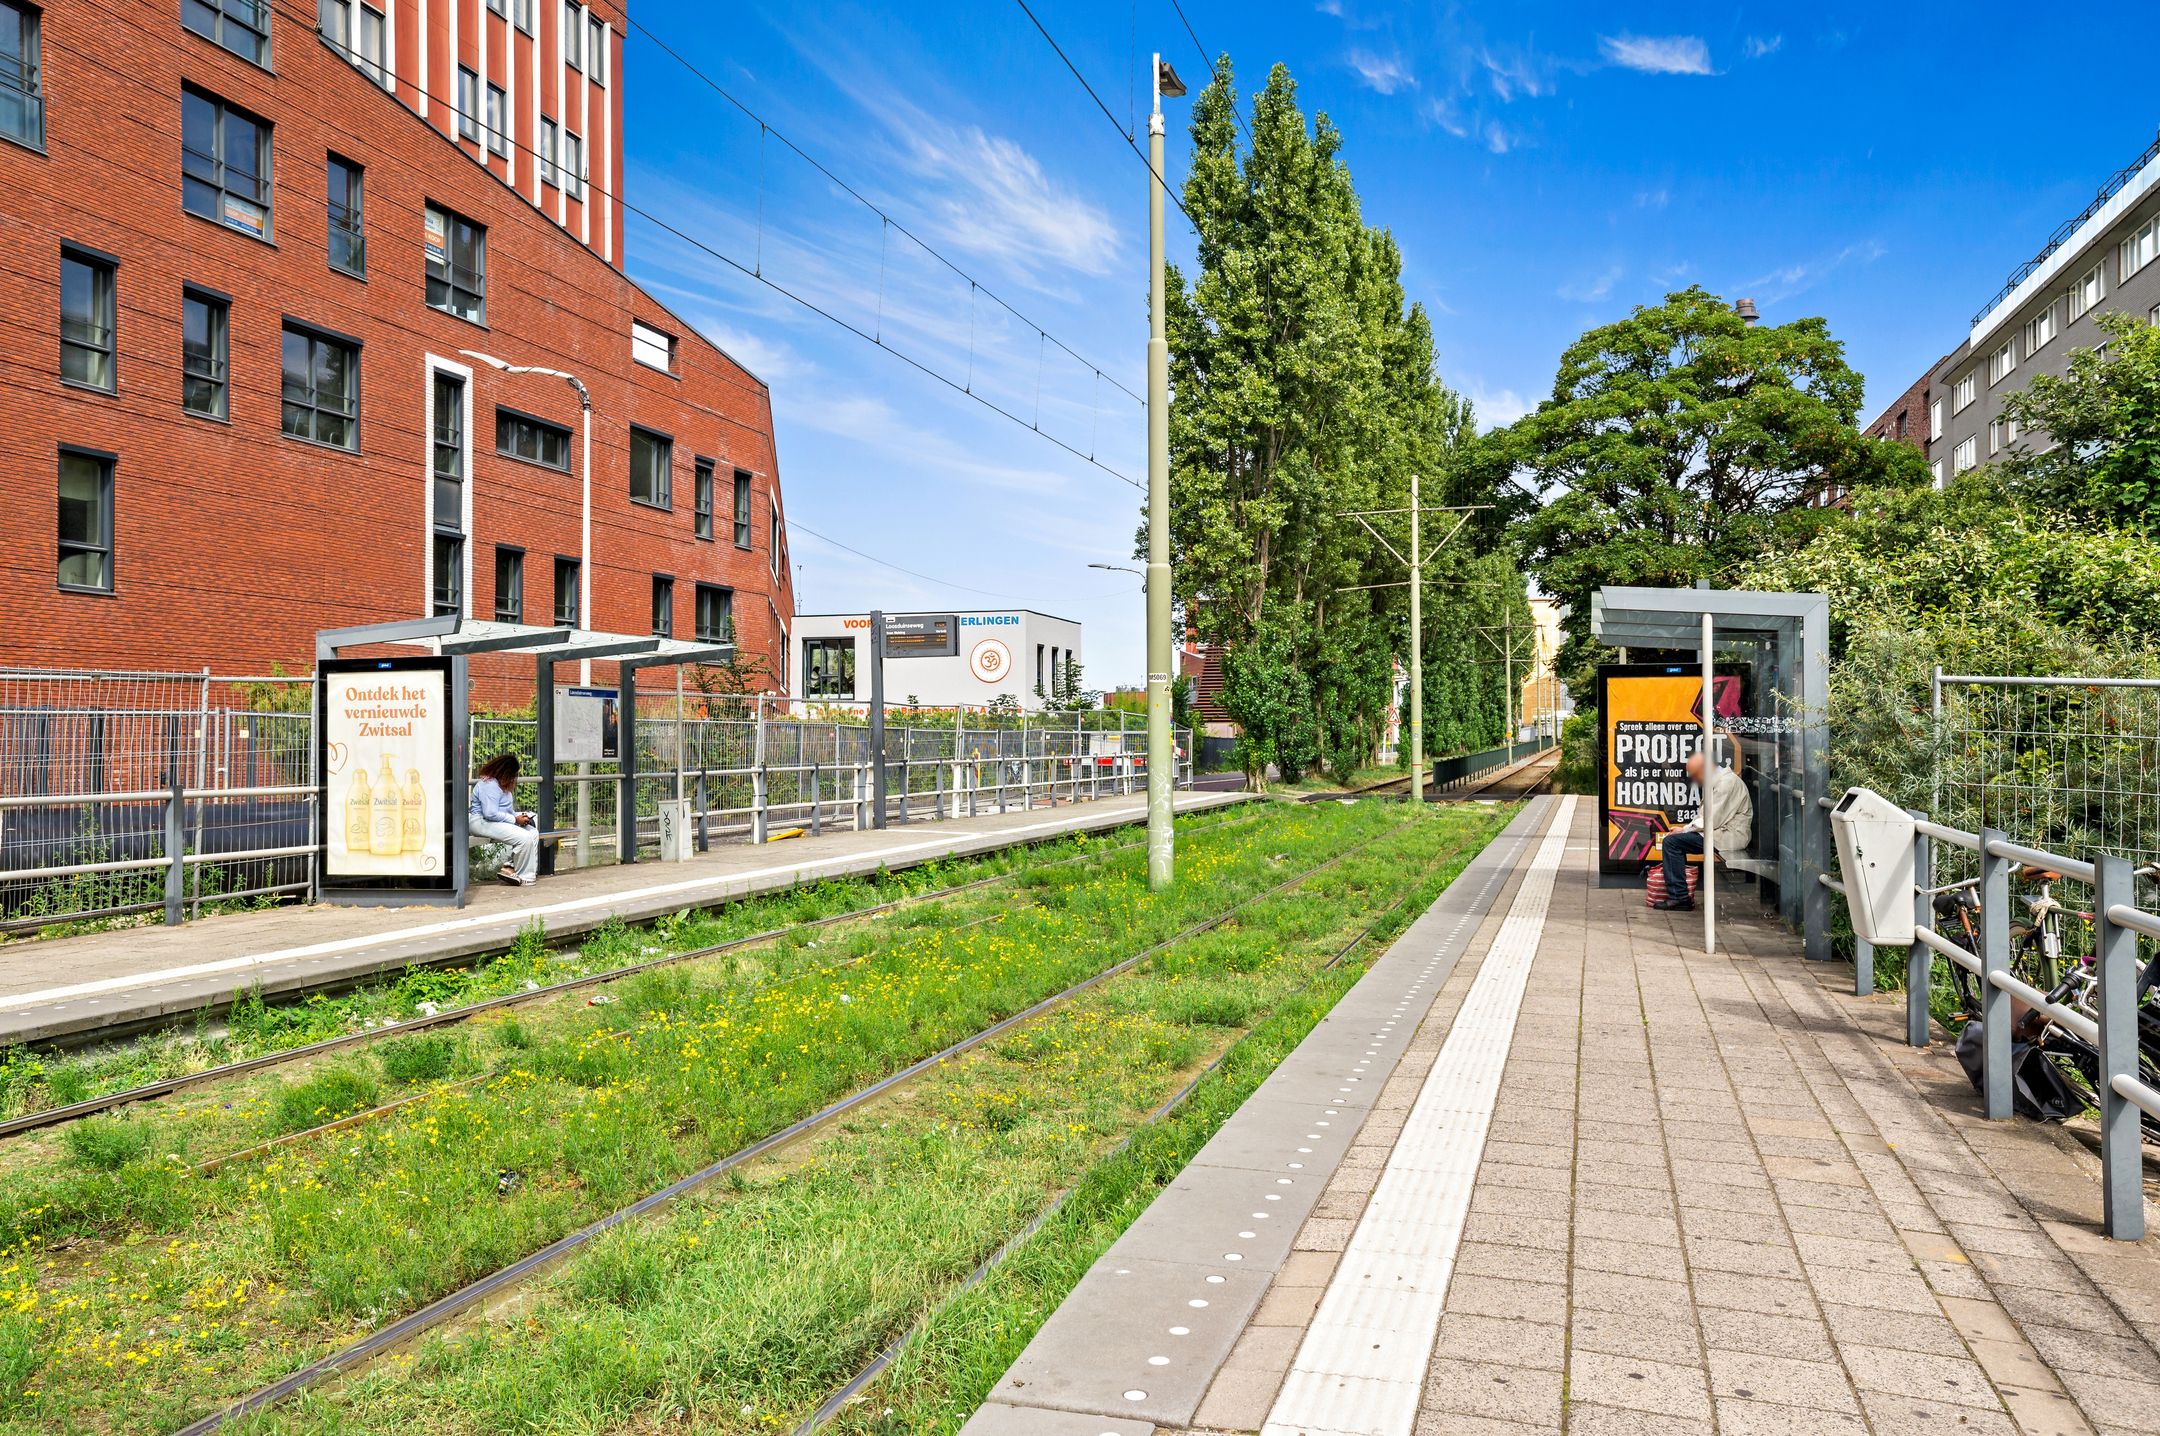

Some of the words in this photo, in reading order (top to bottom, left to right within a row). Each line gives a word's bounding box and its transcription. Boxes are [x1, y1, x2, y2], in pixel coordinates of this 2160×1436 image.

[346, 686, 398, 701] Ontdek
[402, 686, 426, 700] het
[344, 704, 427, 719] vernieuwde
[359, 722, 412, 736] Zwitsal
[1620, 722, 1643, 731] Spreek
[1645, 722, 1666, 730] alleen
[1625, 766, 1638, 777] als
[1640, 767, 1650, 780] je
[1652, 768, 1662, 777] er
[1665, 768, 1683, 777] voor
[1617, 782, 1701, 806] HORNBA
[374, 798, 397, 806] Zwitsal
[1677, 810, 1699, 822] gaa
